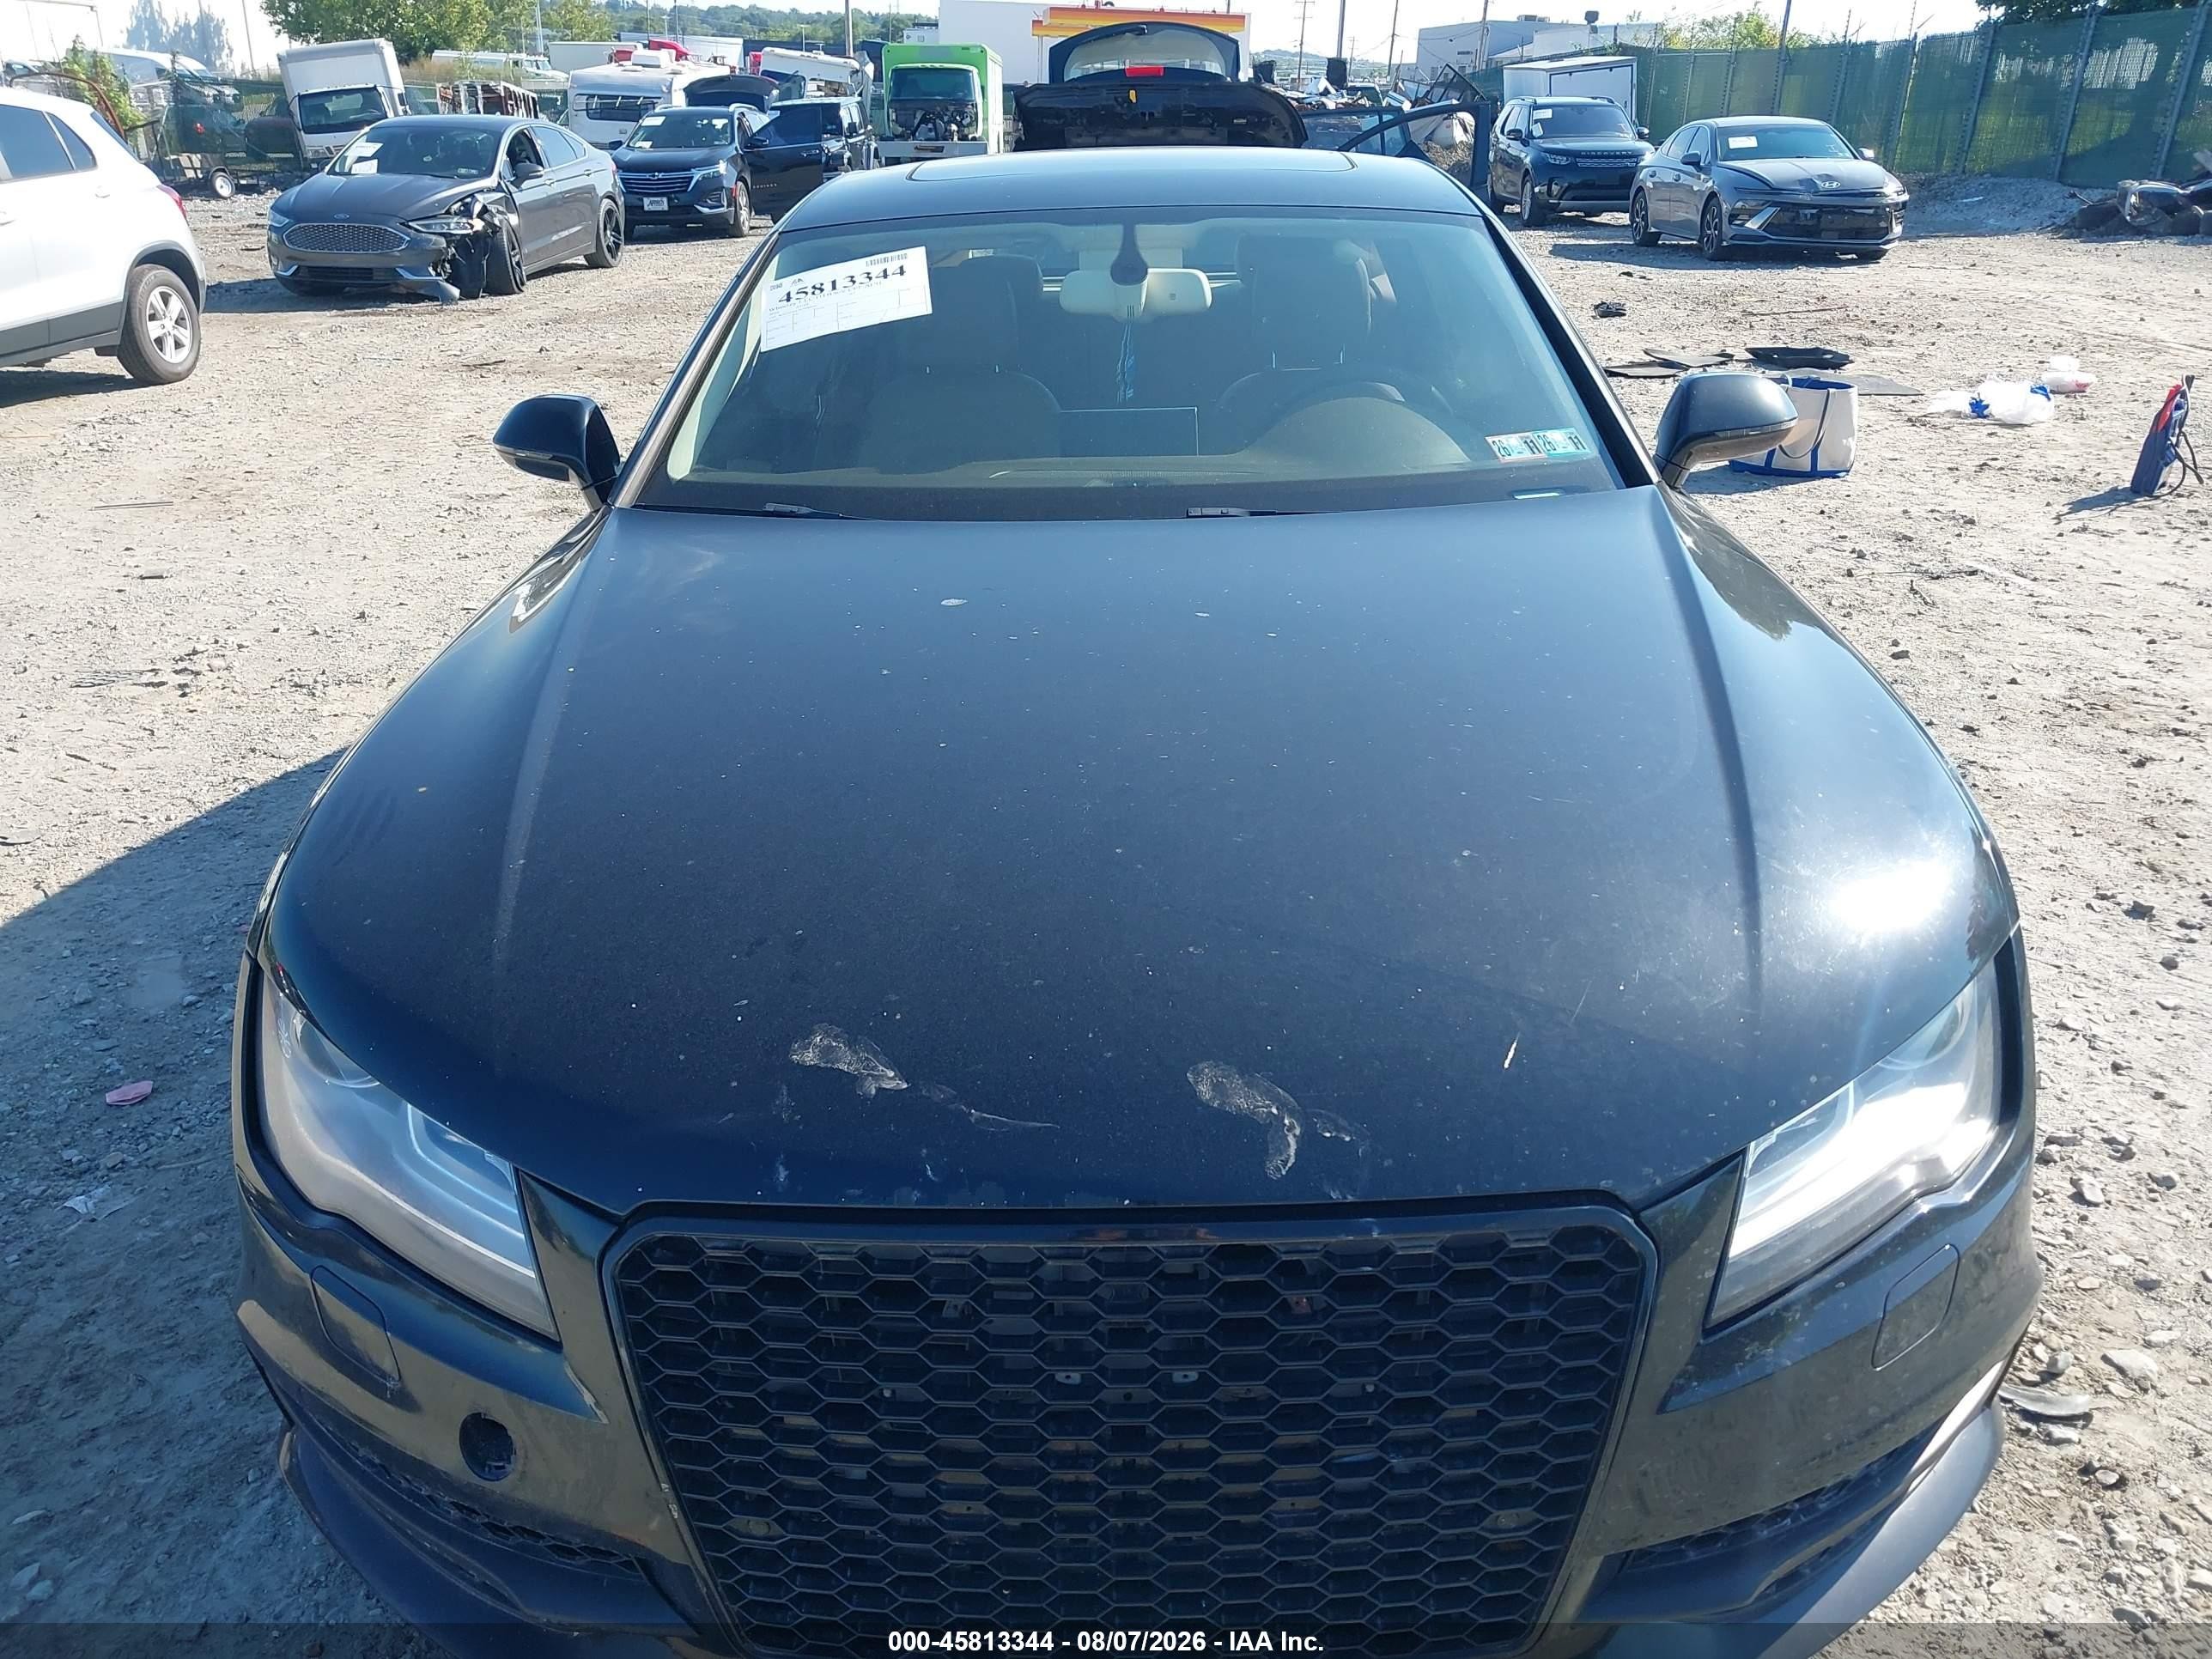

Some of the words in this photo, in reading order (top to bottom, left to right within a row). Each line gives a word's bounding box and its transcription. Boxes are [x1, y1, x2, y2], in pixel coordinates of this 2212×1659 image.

[778, 264, 907, 303] 45813344
[1492, 439, 1512, 458] 26
[1523, 438, 1542, 455] 11
[1536, 434, 1557, 453] 26
[1567, 434, 1587, 451] 11
